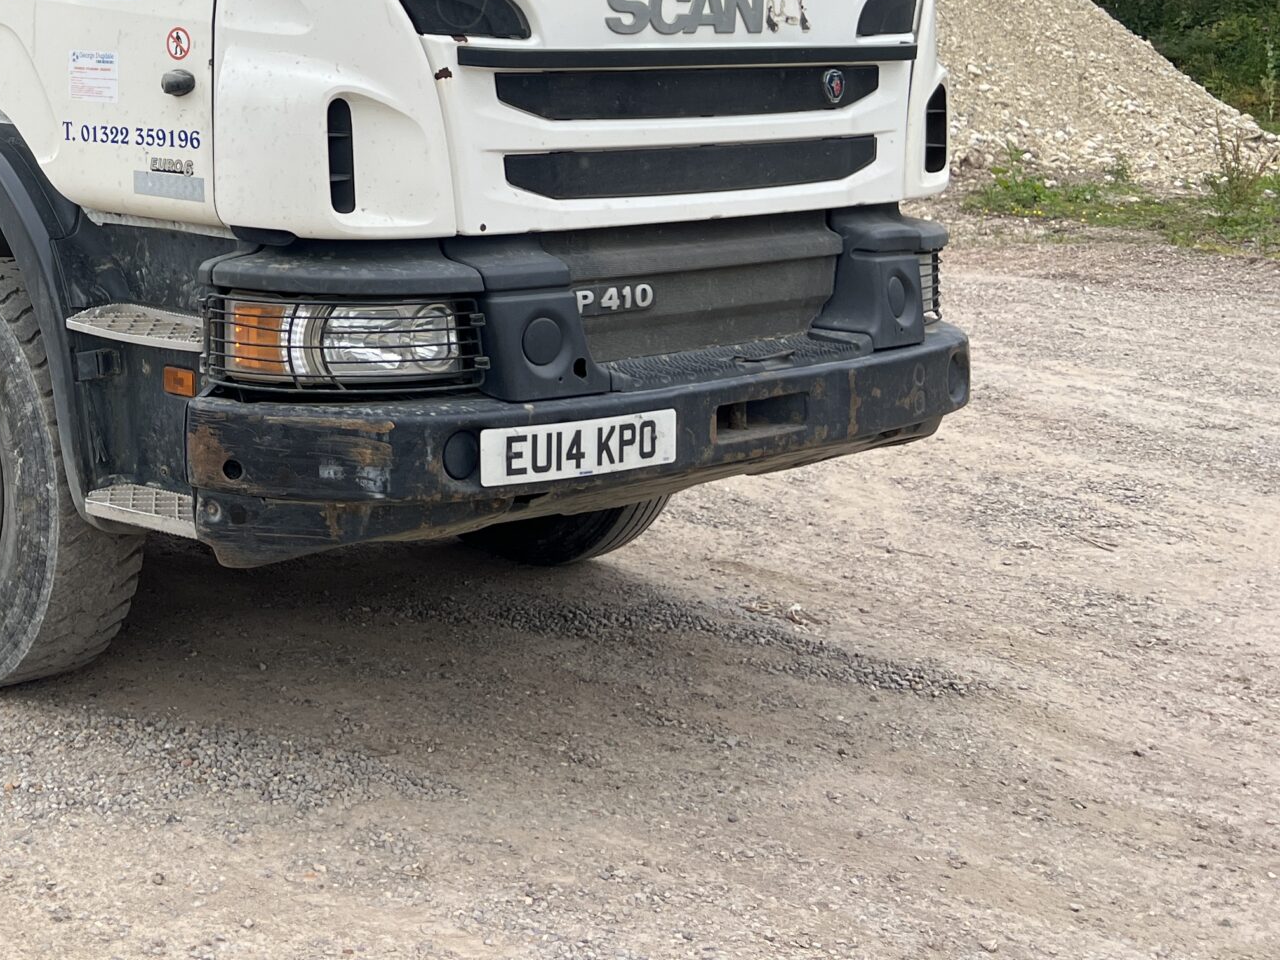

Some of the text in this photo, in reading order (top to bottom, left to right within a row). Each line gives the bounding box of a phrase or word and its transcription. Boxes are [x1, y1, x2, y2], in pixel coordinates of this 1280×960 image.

[81, 125, 129, 145] 01322
[135, 128, 200, 149] 359196
[576, 283, 654, 314] P 410
[506, 419, 657, 477] EU14 KPO
